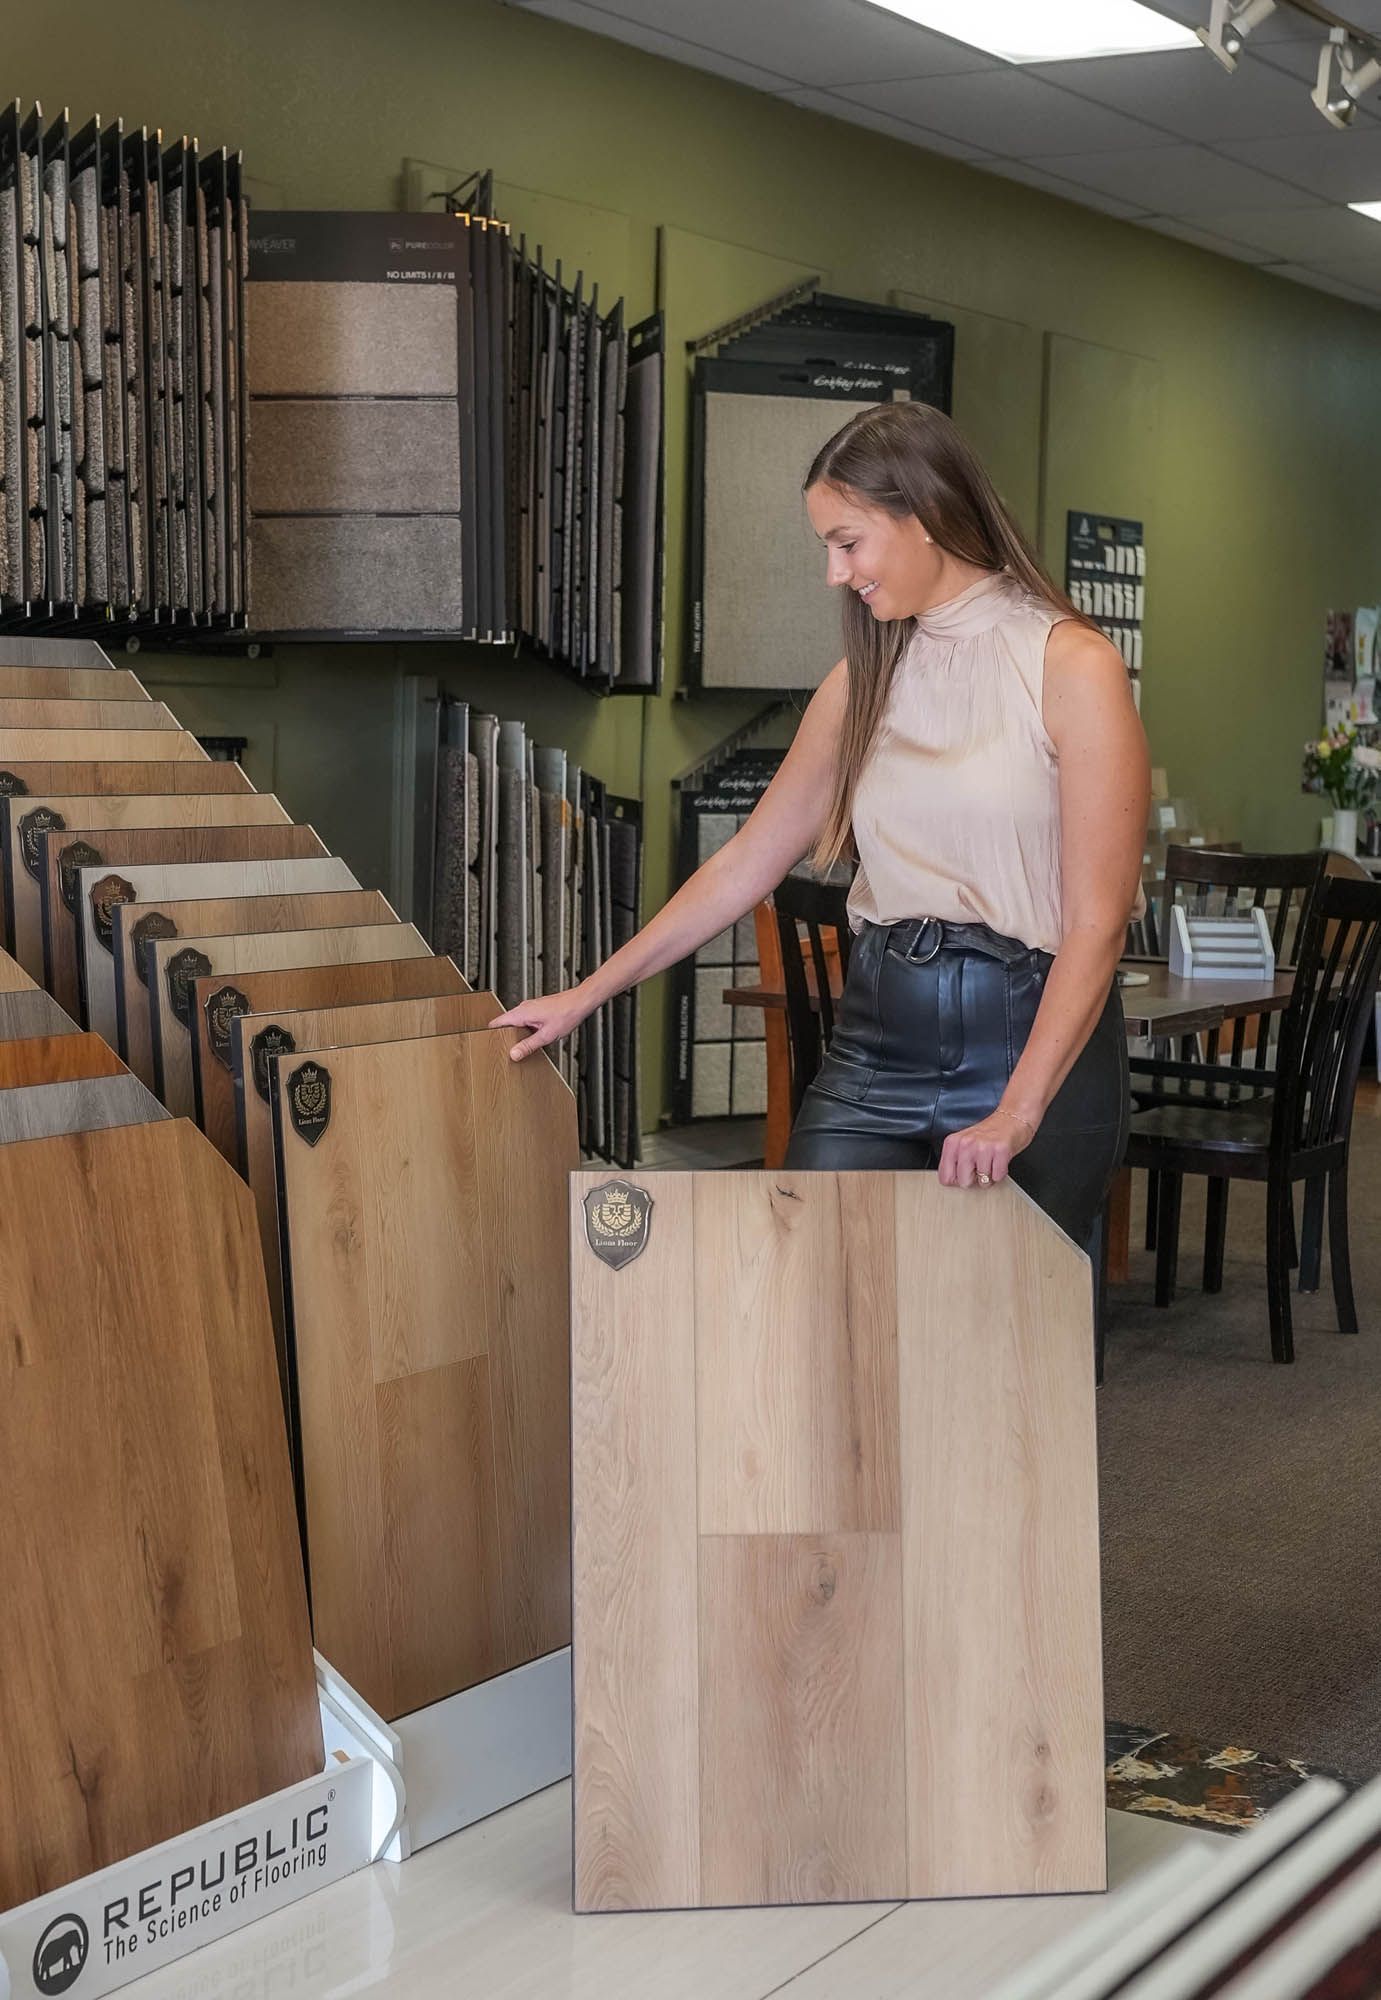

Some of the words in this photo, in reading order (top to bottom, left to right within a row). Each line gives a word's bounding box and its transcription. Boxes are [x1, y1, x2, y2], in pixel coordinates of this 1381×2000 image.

[386, 271, 400, 280] NO
[401, 271, 427, 280] LIMITS
[617, 1239, 638, 1247] Floor
[103, 1934, 138, 1965] The
[147, 1894, 221, 1944] Science
[230, 1875, 247, 1904] of
[254, 1842, 327, 1893] Flooring
